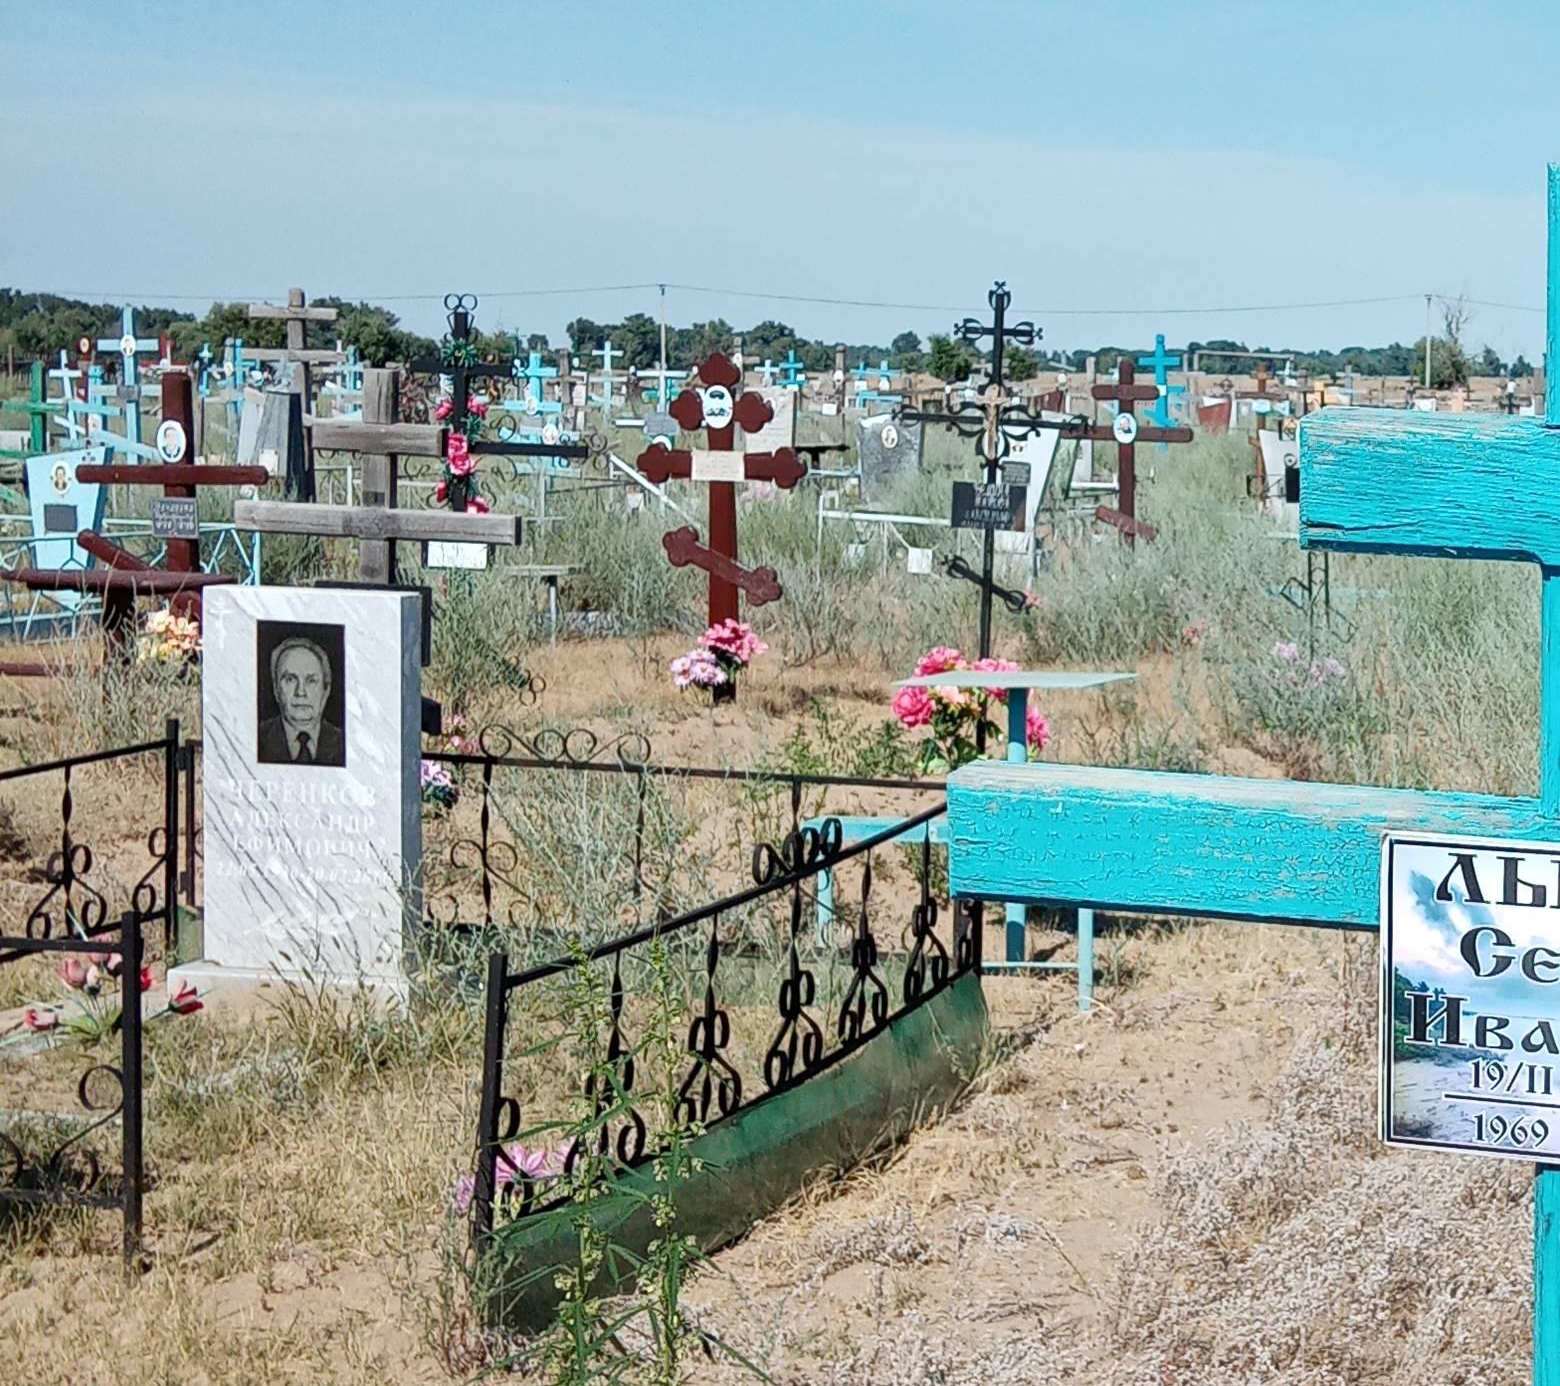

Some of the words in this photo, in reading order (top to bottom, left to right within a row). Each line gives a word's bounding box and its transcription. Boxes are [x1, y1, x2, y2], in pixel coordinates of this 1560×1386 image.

[228, 779, 377, 807] ЧЕРЕНКОВ
[228, 807, 376, 835] АЛЕКСАНДР
[1470, 1059, 1553, 1096] 19/II
[1473, 1114, 1550, 1148] 1969
